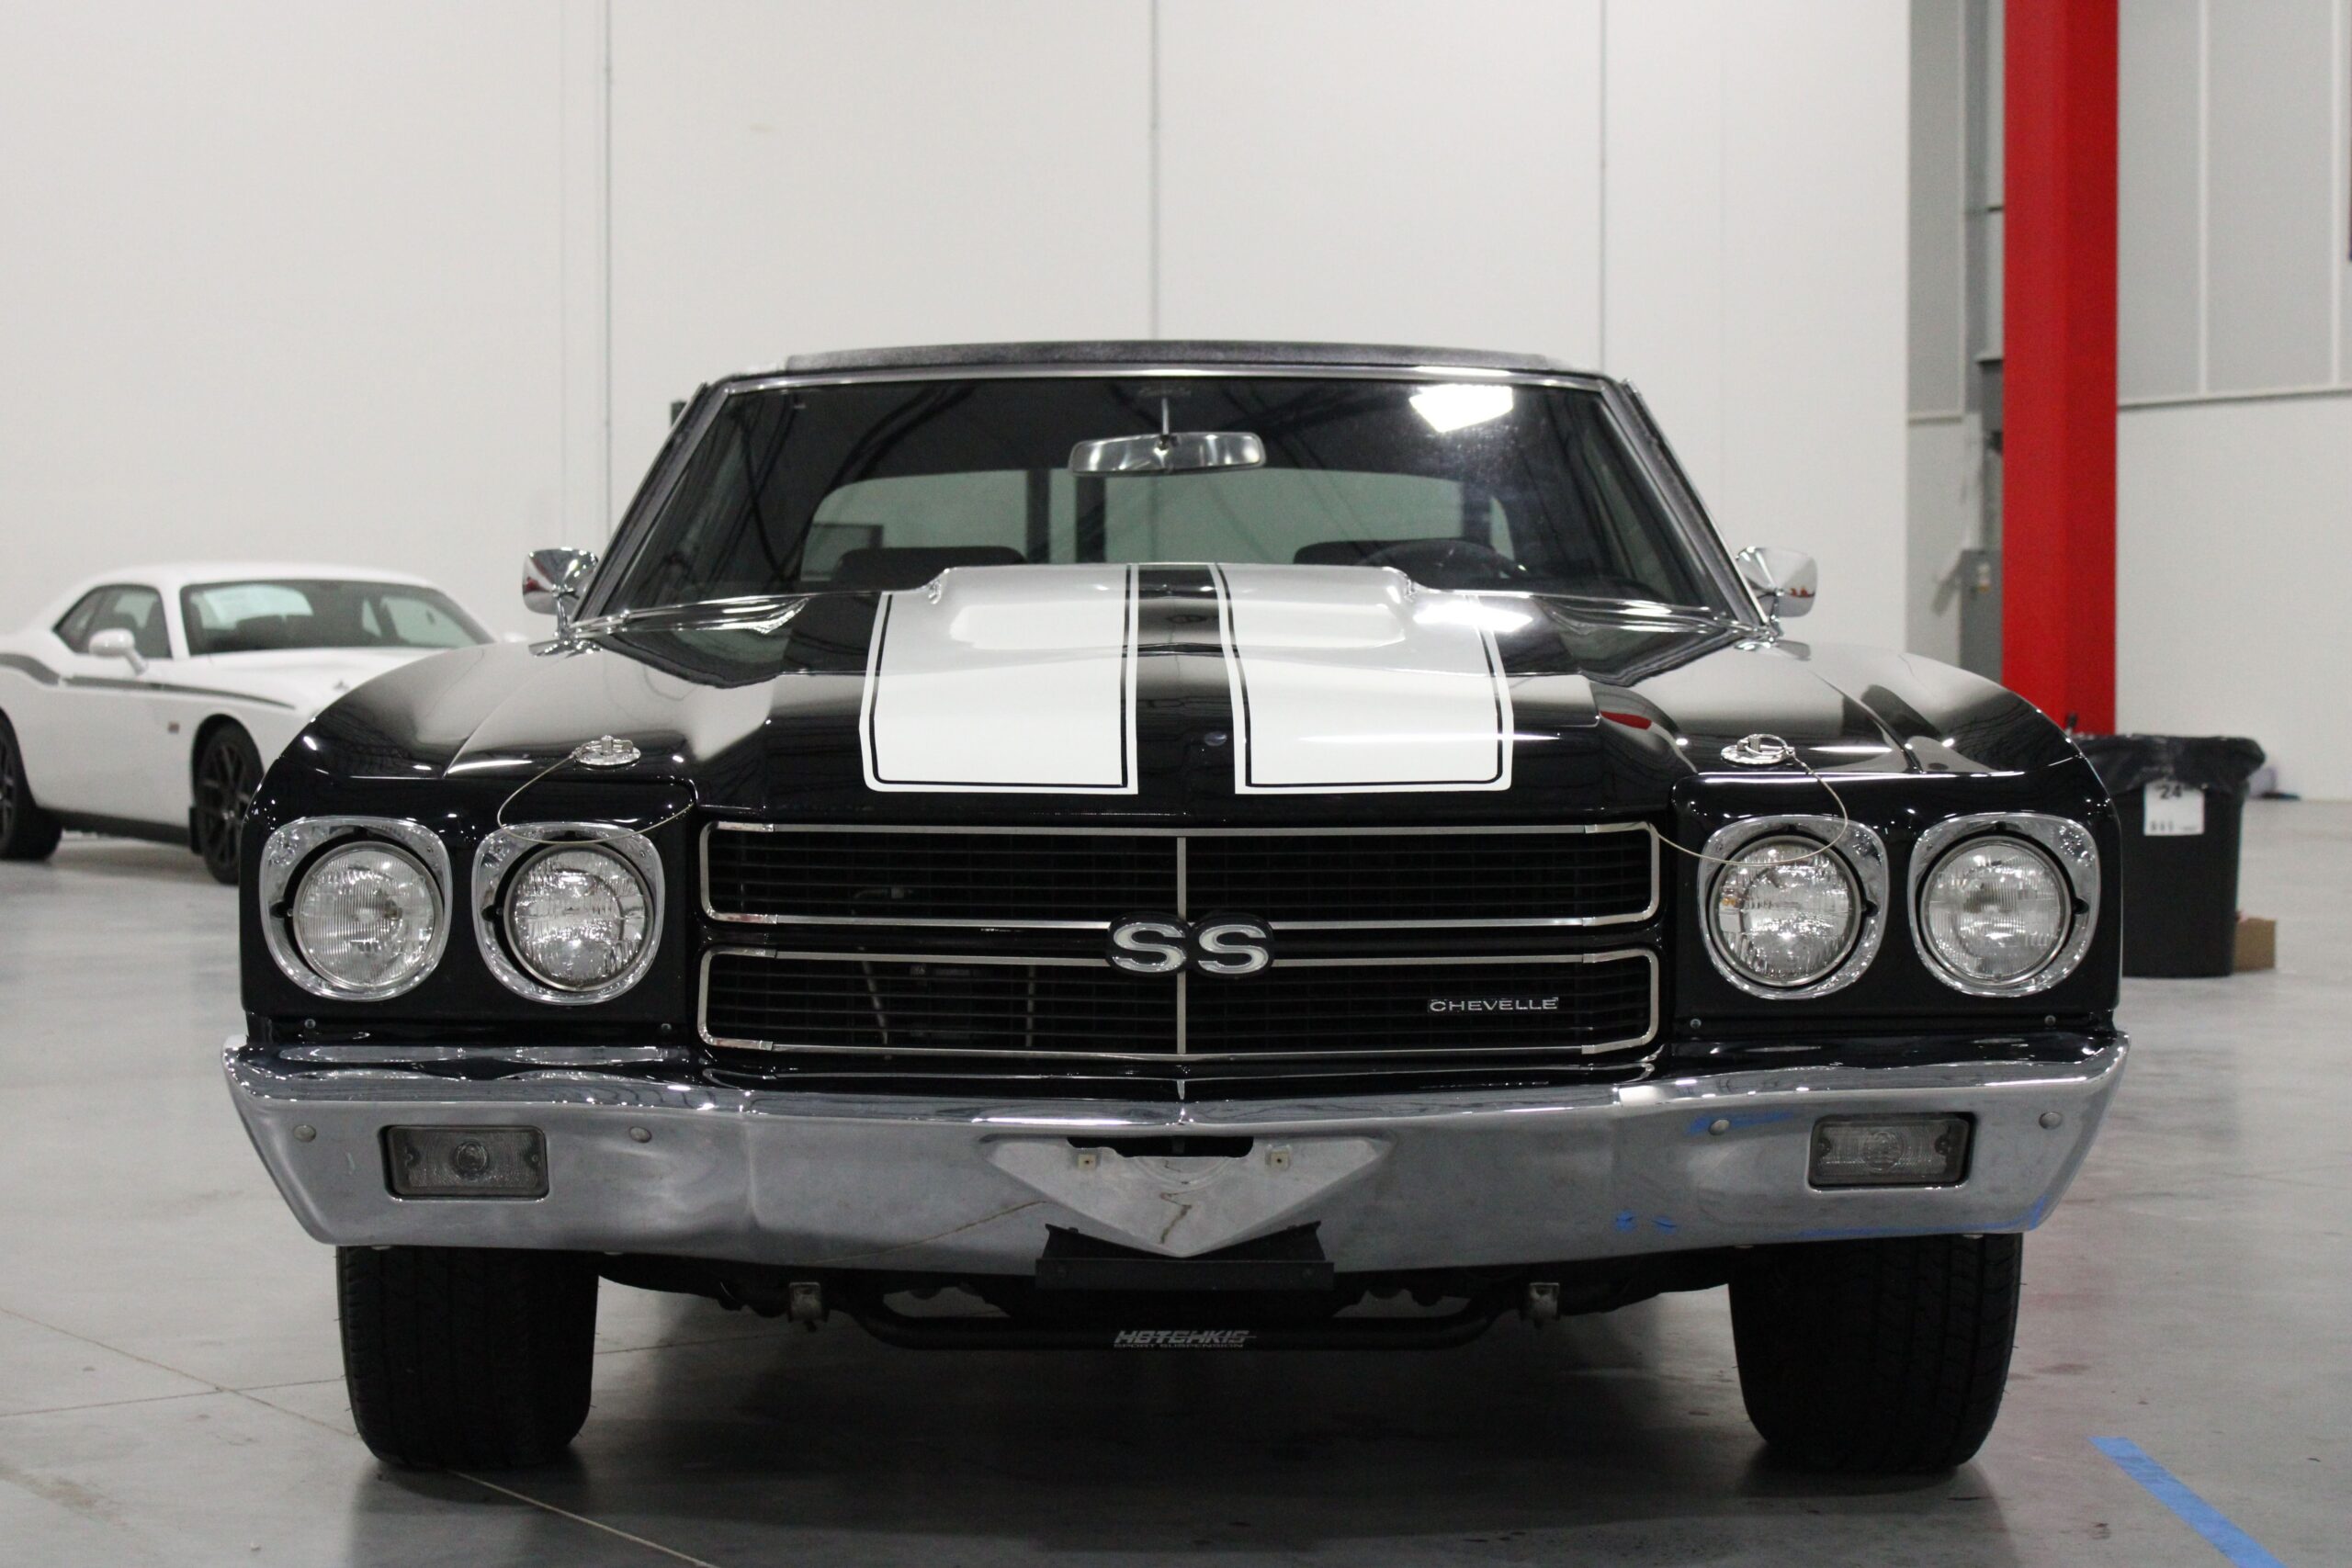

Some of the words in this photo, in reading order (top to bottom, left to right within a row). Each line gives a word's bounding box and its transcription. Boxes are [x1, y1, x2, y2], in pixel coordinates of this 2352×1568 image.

[1112, 921, 1270, 975] SS
[1429, 998, 1559, 1012] CHEVELLE
[1114, 1330, 1252, 1344] HOTCHKIS
